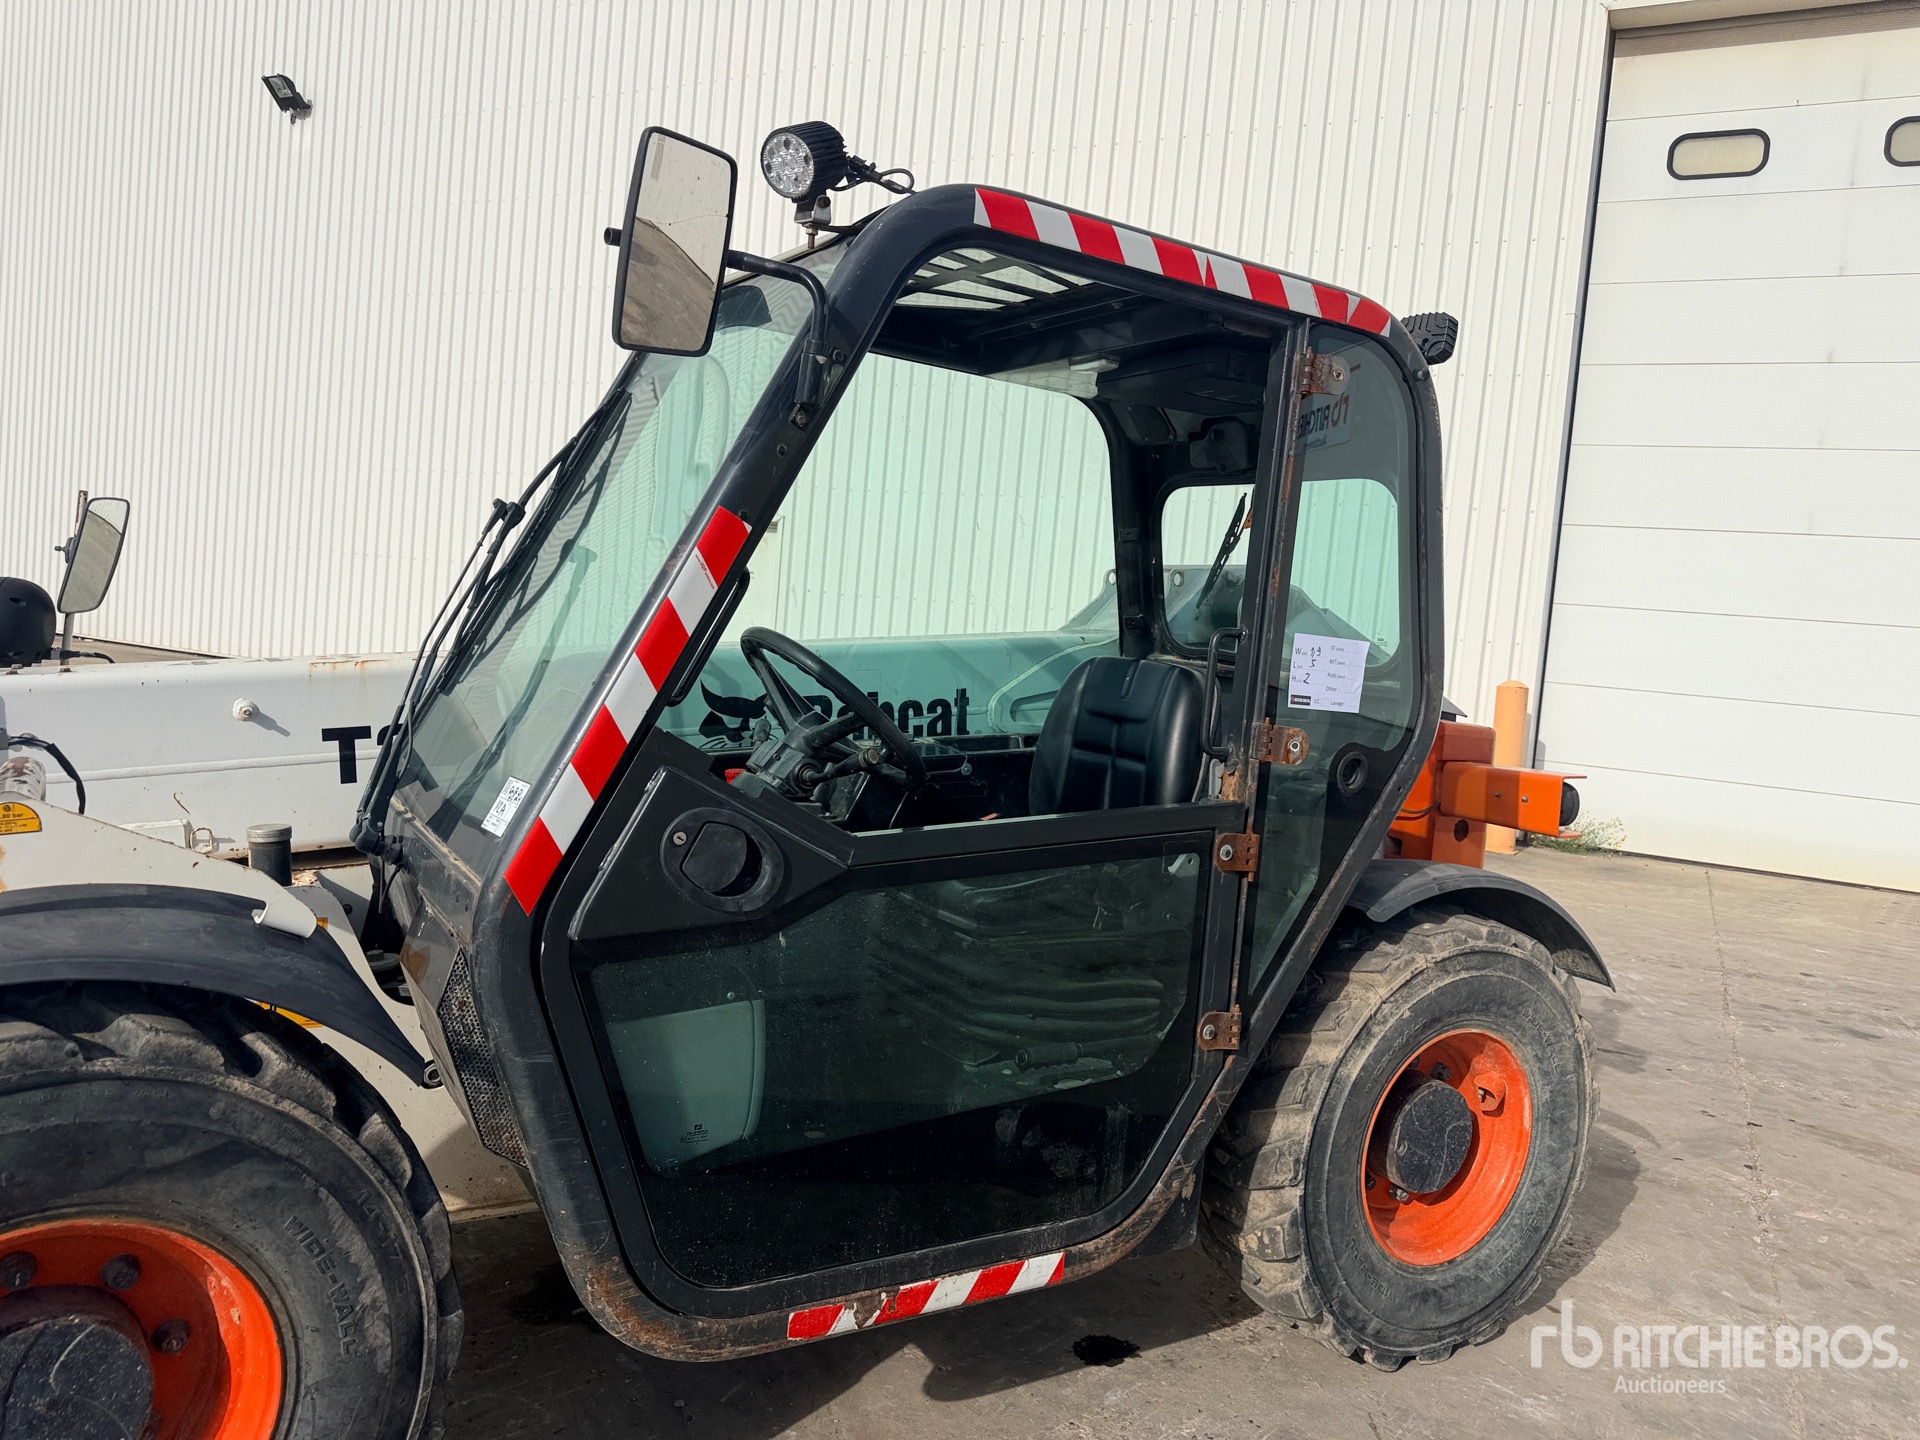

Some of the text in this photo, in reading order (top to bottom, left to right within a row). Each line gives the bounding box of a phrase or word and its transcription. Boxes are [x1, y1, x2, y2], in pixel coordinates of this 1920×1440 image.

[1303, 672, 1311, 684] 2
[283, 1215, 358, 1356] WIDE-WALL
[356, 1188, 410, 1297] 14-175
